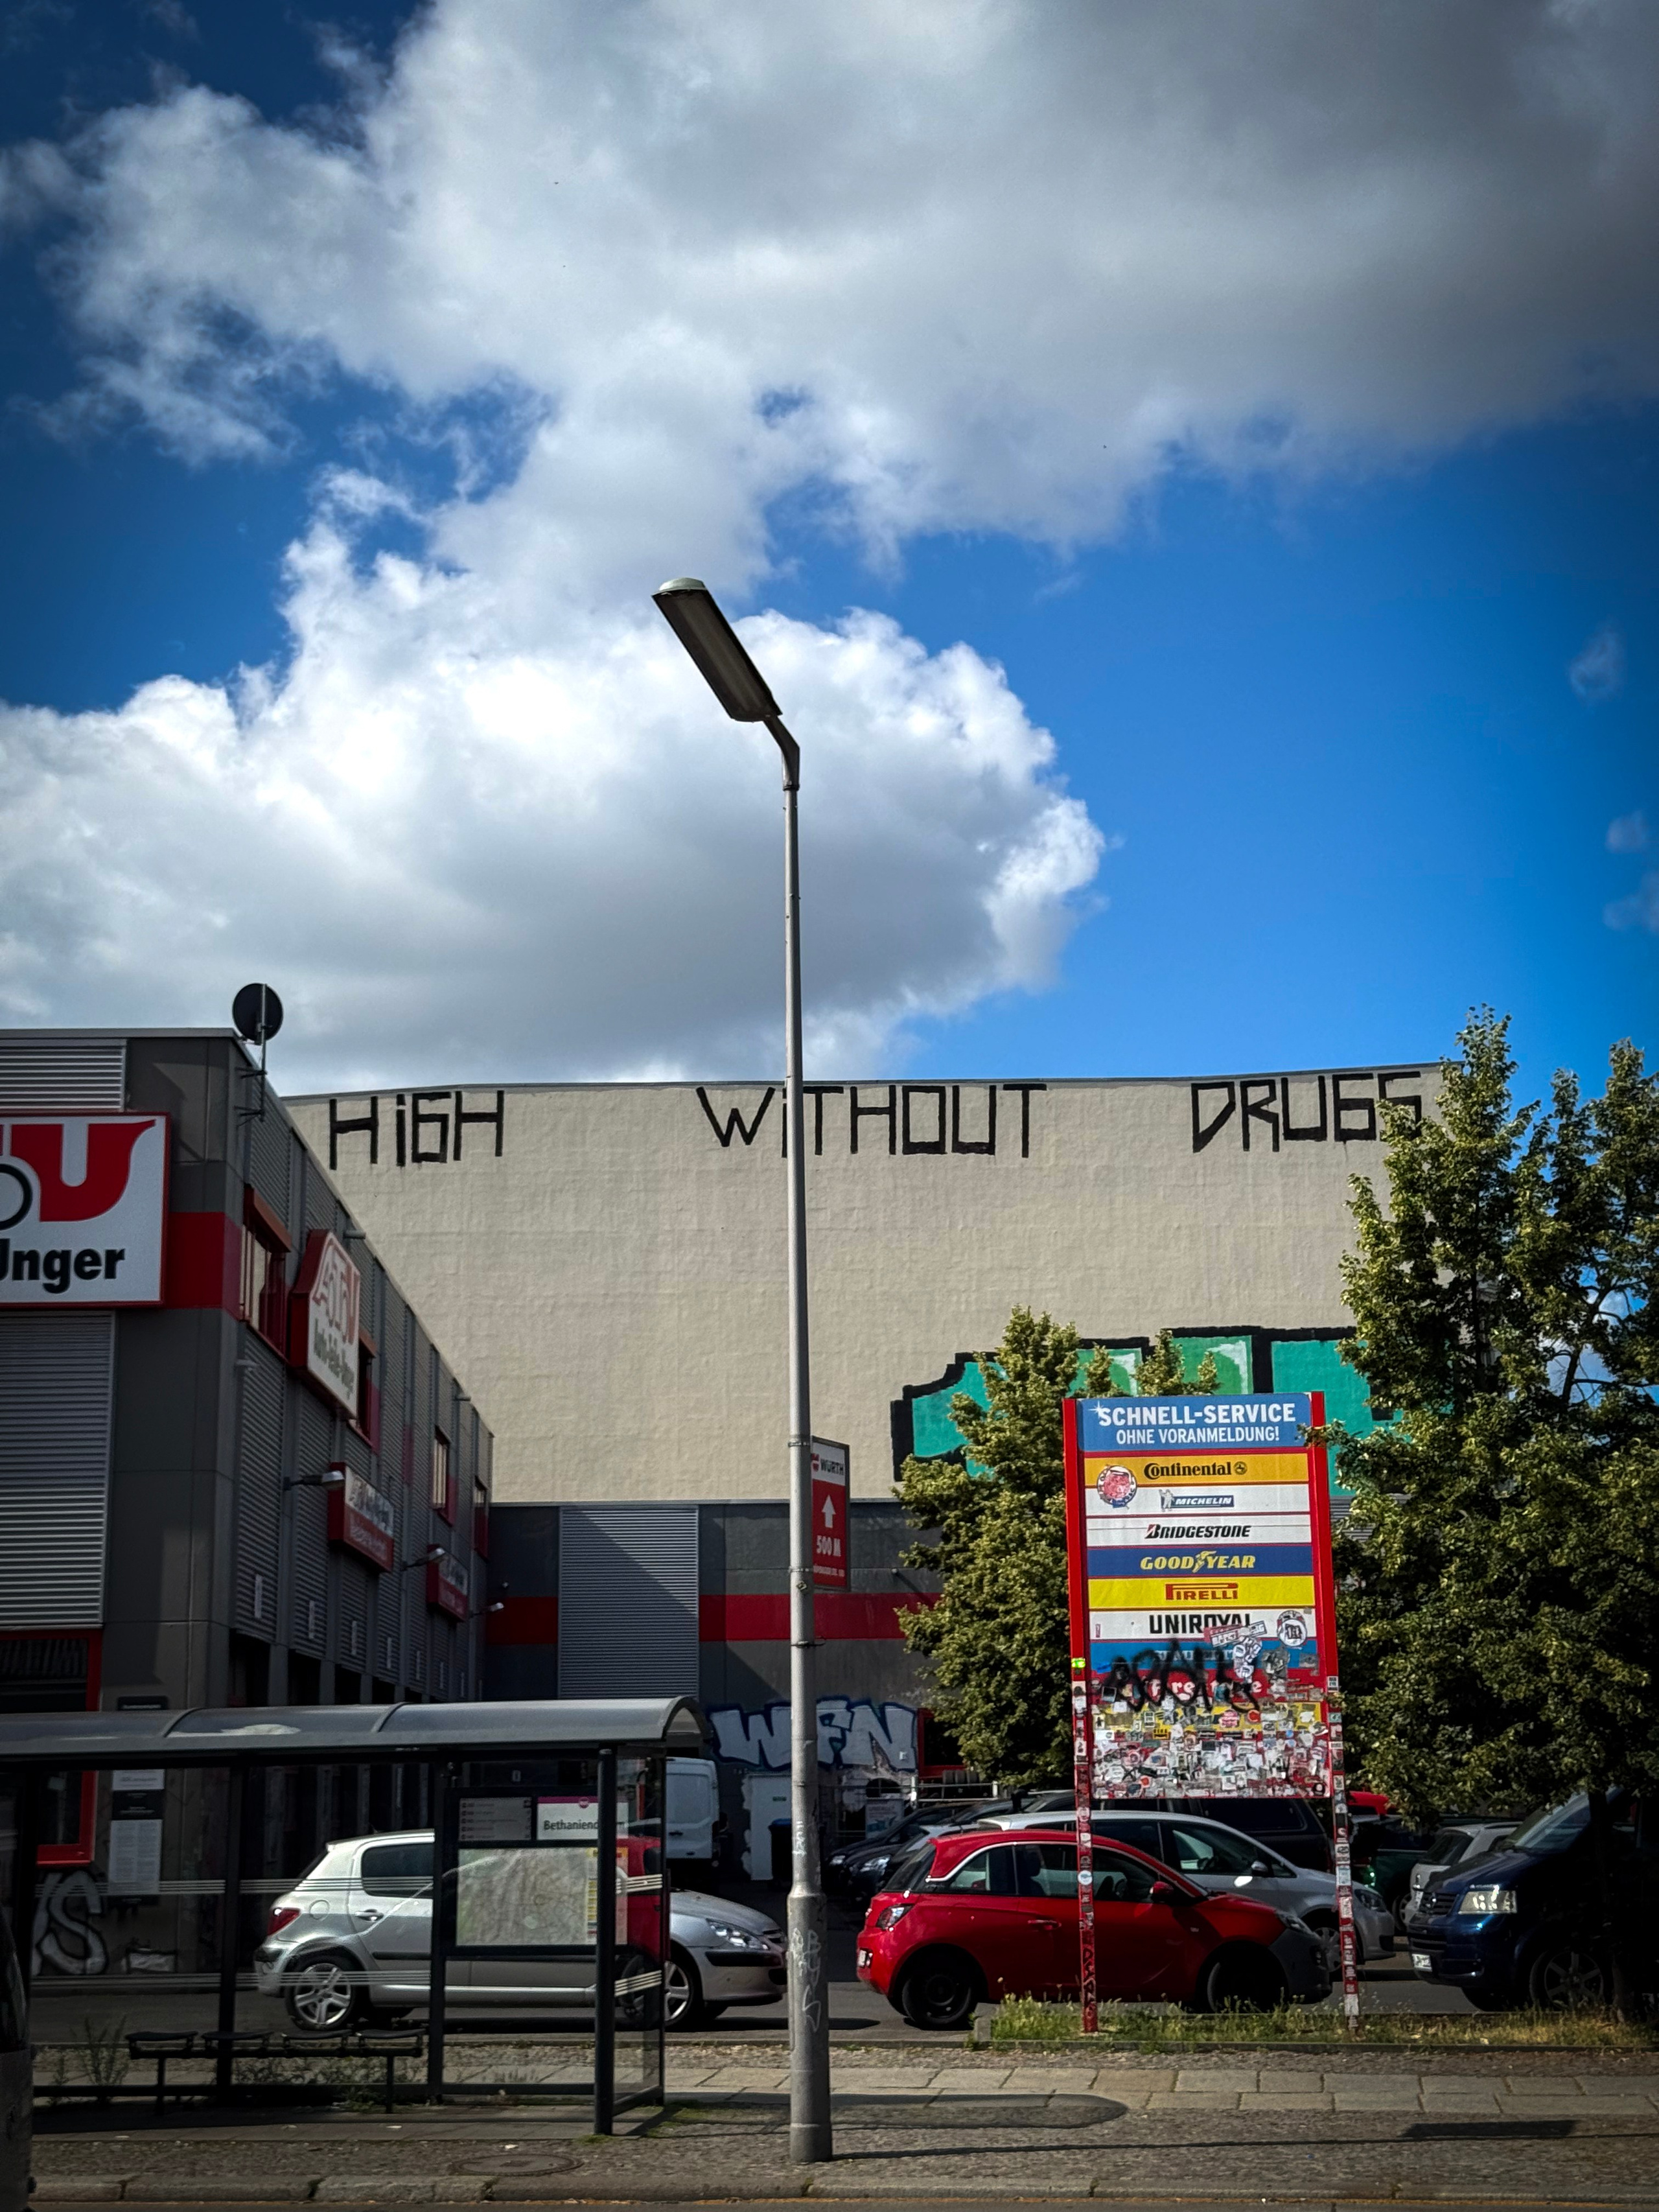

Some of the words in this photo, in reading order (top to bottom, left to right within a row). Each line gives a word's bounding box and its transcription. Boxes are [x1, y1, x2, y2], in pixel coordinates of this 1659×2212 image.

[1191, 1071, 1421, 1154] DRUGS
[1099, 1403, 1296, 1426] SCHNELL-SERVICE
[1116, 1429, 1155, 1445] OHNE
[1159, 1426, 1280, 1444] VORANMELDUNG!
[1144, 1461, 1232, 1480] Continental
[1175, 1497, 1232, 1506] MICHELIN
[1144, 1524, 1252, 1540] BRIDGESTONE
[817, 1535, 832, 1555] 500
[1140, 1554, 1256, 1571] GOODYEAR
[1165, 1583, 1238, 1601] PIRELLI
